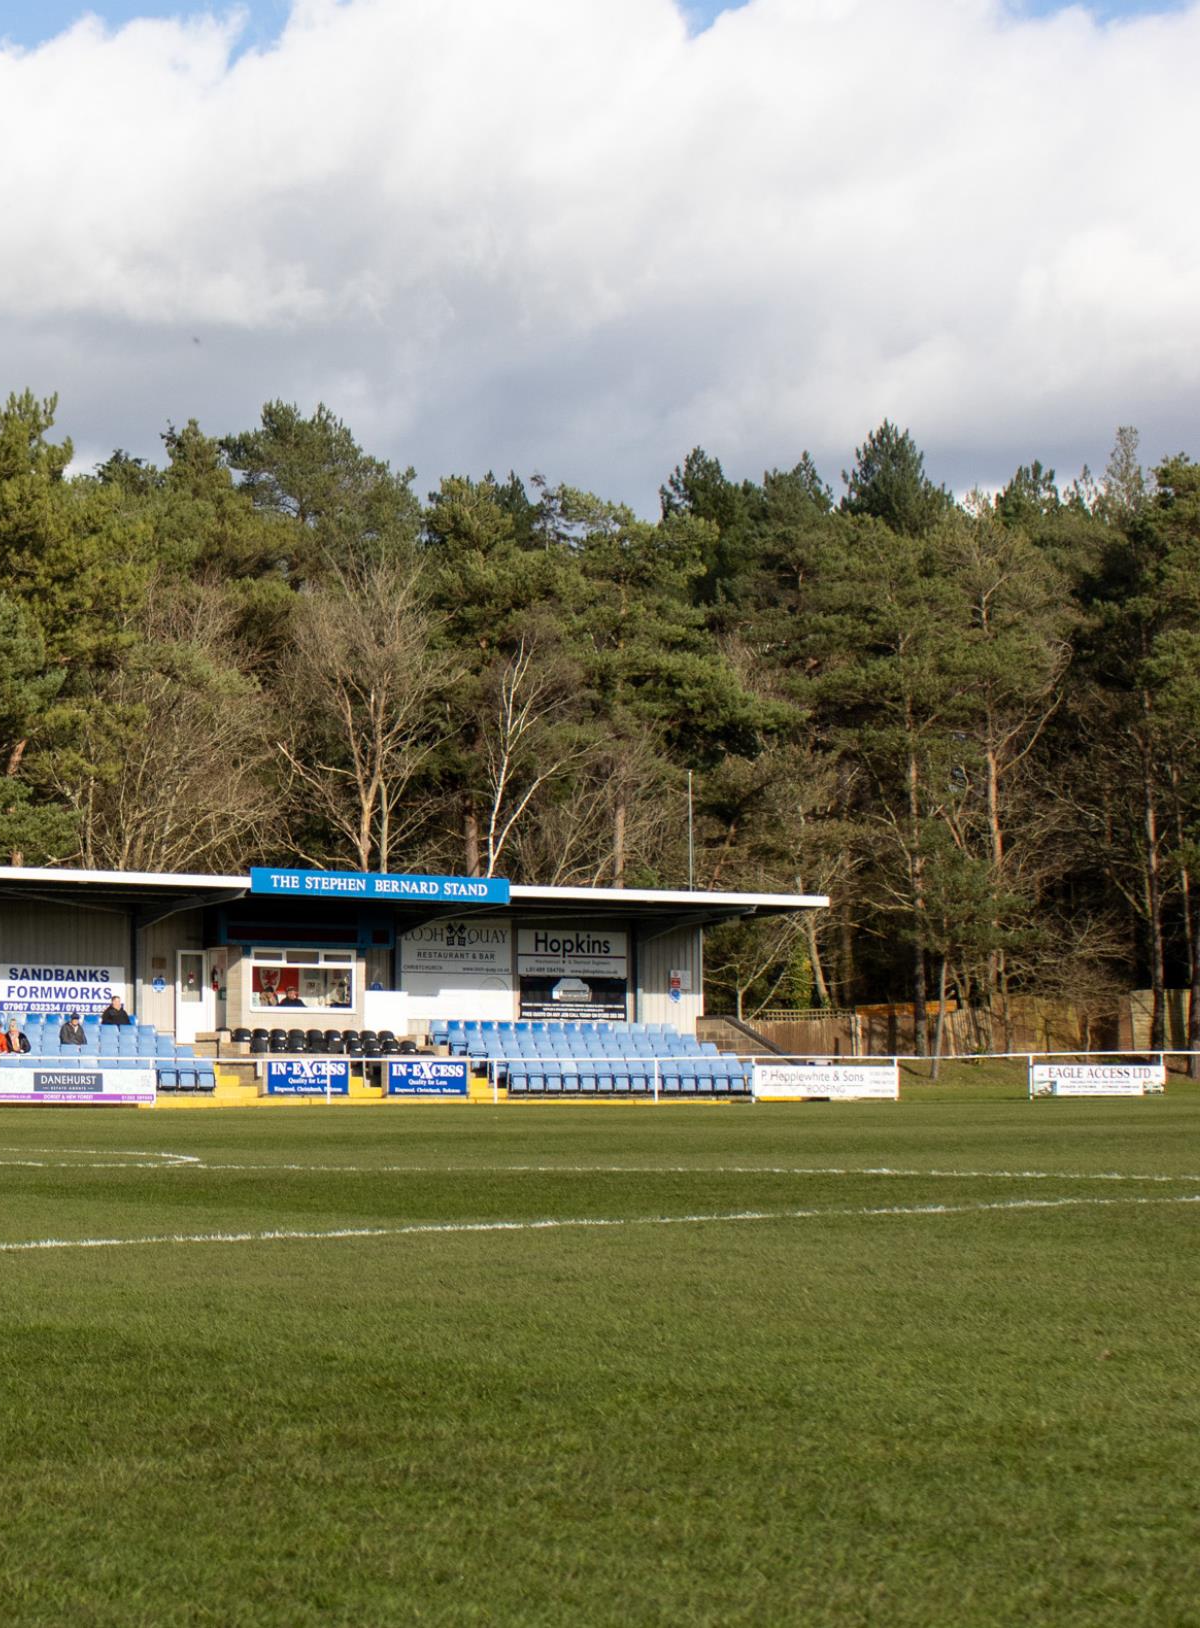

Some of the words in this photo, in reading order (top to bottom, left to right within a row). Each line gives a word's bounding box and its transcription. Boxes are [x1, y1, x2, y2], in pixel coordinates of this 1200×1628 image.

[270, 874, 300, 889] THE
[304, 876, 366, 891] STEPHEN
[374, 879, 439, 895] BERNARD
[443, 882, 488, 897] STAND
[467, 928, 508, 944] QUAY
[534, 931, 610, 958] Hopkins
[417, 951, 469, 959] RESTAURANT
[472, 952, 477, 960] &
[478, 952, 495, 960] BAR
[9, 967, 110, 982] SANDBANKS
[7, 985, 113, 1000] FORMWORKS
[271, 1060, 346, 1078] IN-EXCESS
[392, 1061, 464, 1079] IN-EXCESS
[770, 1069, 830, 1083] Hepplewhite
[832, 1070, 839, 1081] &
[843, 1071, 864, 1082] Sons
[1048, 1067, 1084, 1078] EAGLE
[1087, 1067, 1130, 1078] ACCESS
[1132, 1067, 1151, 1078] LTD
[40, 1075, 96, 1085] DANEHURST
[288, 1077, 307, 1085] Quality
[806, 1085, 846, 1093] ROOFING
